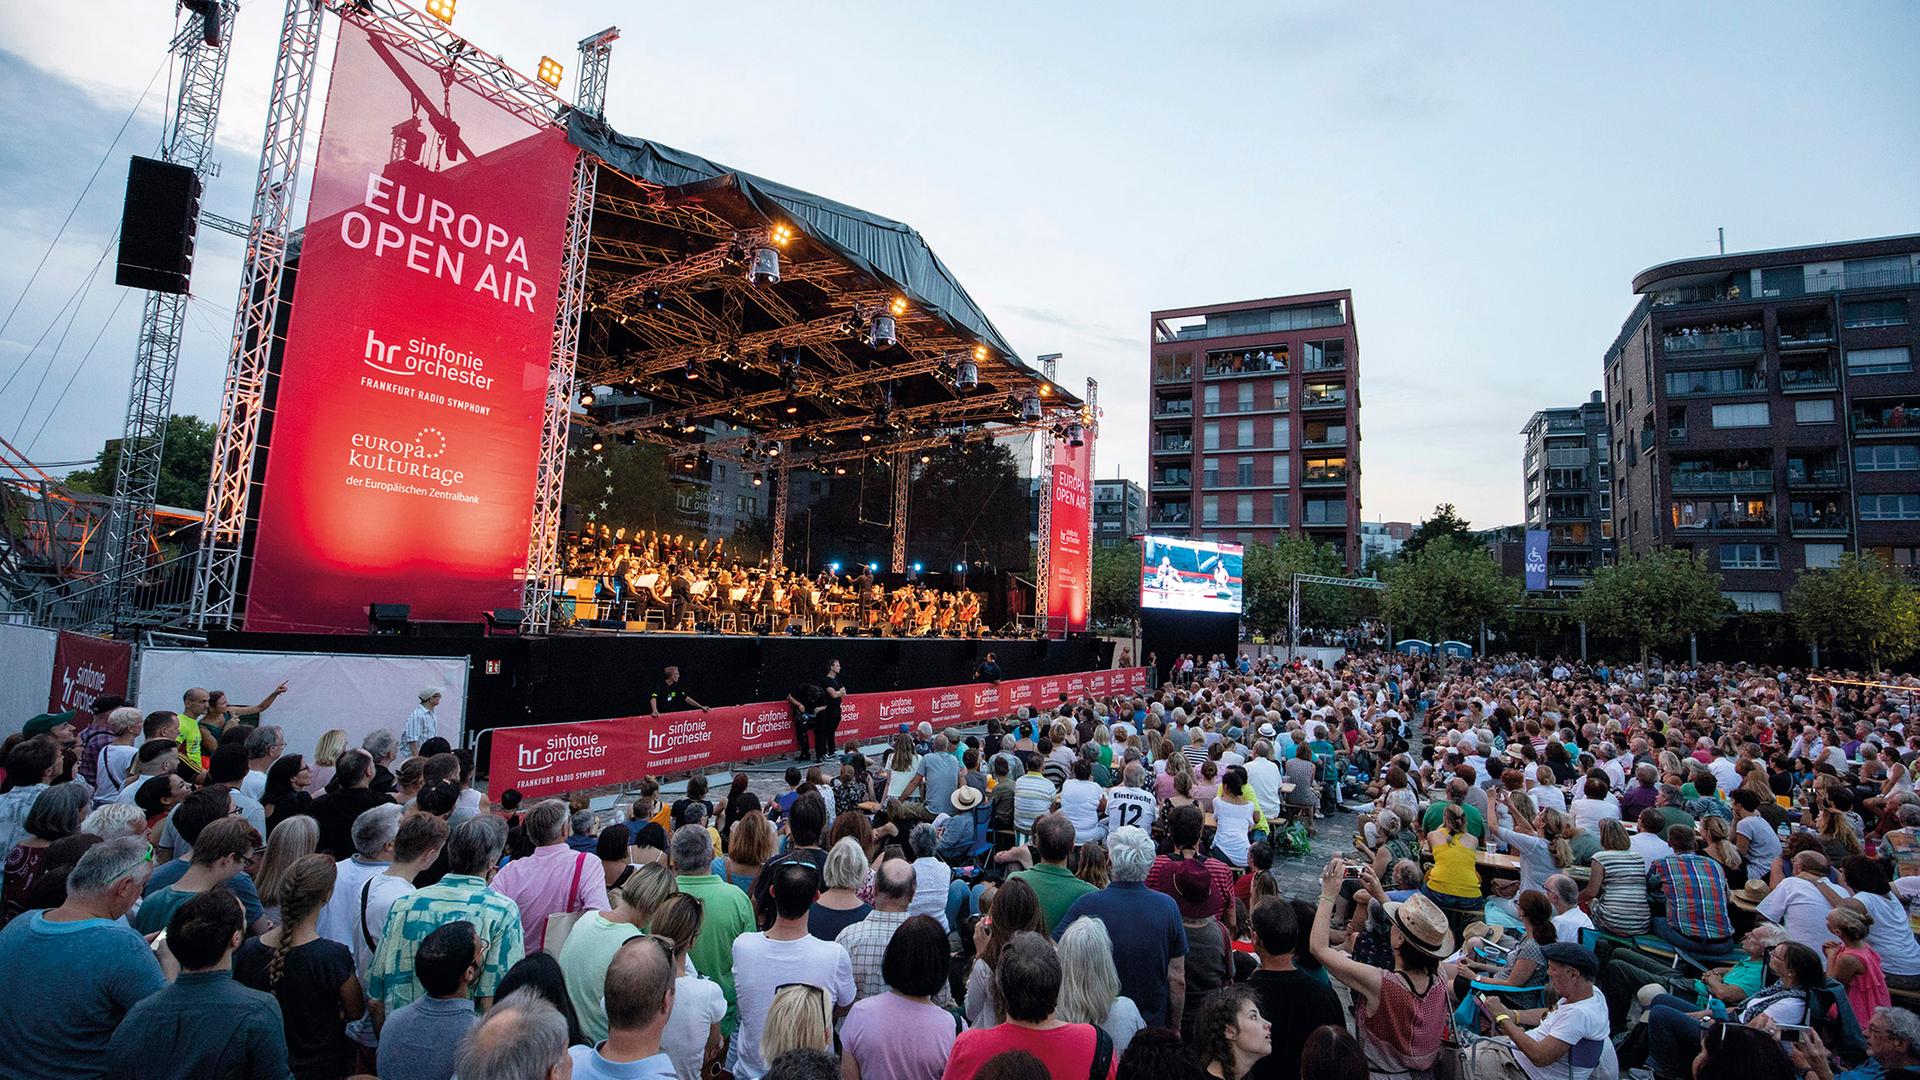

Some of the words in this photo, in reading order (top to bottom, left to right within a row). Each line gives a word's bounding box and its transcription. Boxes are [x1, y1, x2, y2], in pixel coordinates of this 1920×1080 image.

[364, 172, 529, 271] EUROPA
[341, 211, 465, 285] OPEN
[473, 263, 537, 313] AIR
[364, 329, 401, 364] hr
[408, 337, 483, 371] sinfonie
[405, 356, 494, 390] orchester
[360, 376, 416, 398] FRANKFURT
[418, 390, 445, 405] RADIO
[447, 397, 490, 416] SYMPHONY
[345, 475, 363, 486] der
[365, 478, 428, 496] Europäischen
[429, 487, 480, 504] Zentralbank
[1059, 471, 1085, 494] EUROPA
[1056, 487, 1075, 506] OPEN
[1075, 497, 1087, 510] AIR
[1525, 563, 1545, 573] WC
[62, 666, 75, 704] hr
[76, 661, 105, 691] sinfonie
[880, 702, 889, 716] hr
[891, 697, 912, 707] sinfonie
[890, 705, 915, 716] orchester
[648, 729, 666, 749] hr
[668, 718, 707, 734] sinfonie
[742, 717, 756, 735] hr
[758, 709, 788, 723] sinfonie
[757, 720, 792, 733] orchester
[518, 744, 542, 766] hr
[546, 731, 599, 750] sinfonie
[667, 731, 712, 746] orchester
[545, 745, 607, 763] orchester
[646, 757, 673, 768] FRANKFURT
[674, 755, 687, 763] RADIO
[517, 776, 554, 788] FRANKFURT
[555, 773, 574, 783] RADIO
[575, 769, 606, 780] SYMPHONY
[1118, 802, 1143, 828] 12
